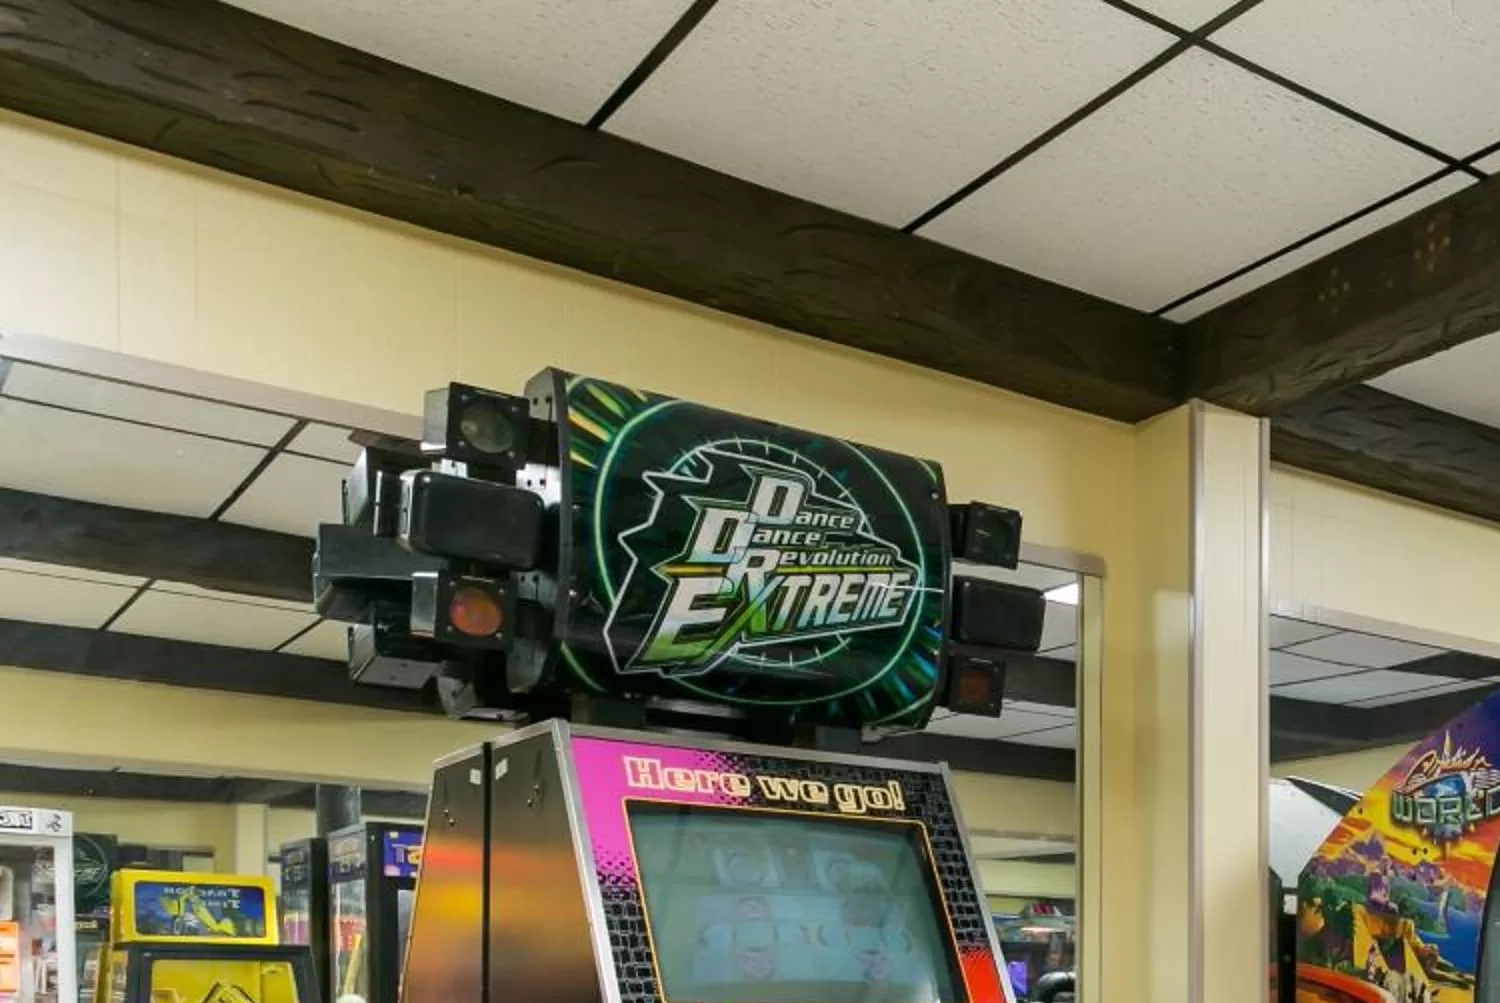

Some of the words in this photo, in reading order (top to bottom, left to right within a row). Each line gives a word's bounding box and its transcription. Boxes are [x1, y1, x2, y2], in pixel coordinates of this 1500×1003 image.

[747, 474, 855, 530] Dance
[689, 507, 821, 563] Dance
[727, 548, 893, 593] Revolution
[623, 755, 752, 797] Here
[759, 776, 829, 804] we
[834, 779, 906, 813] go!
